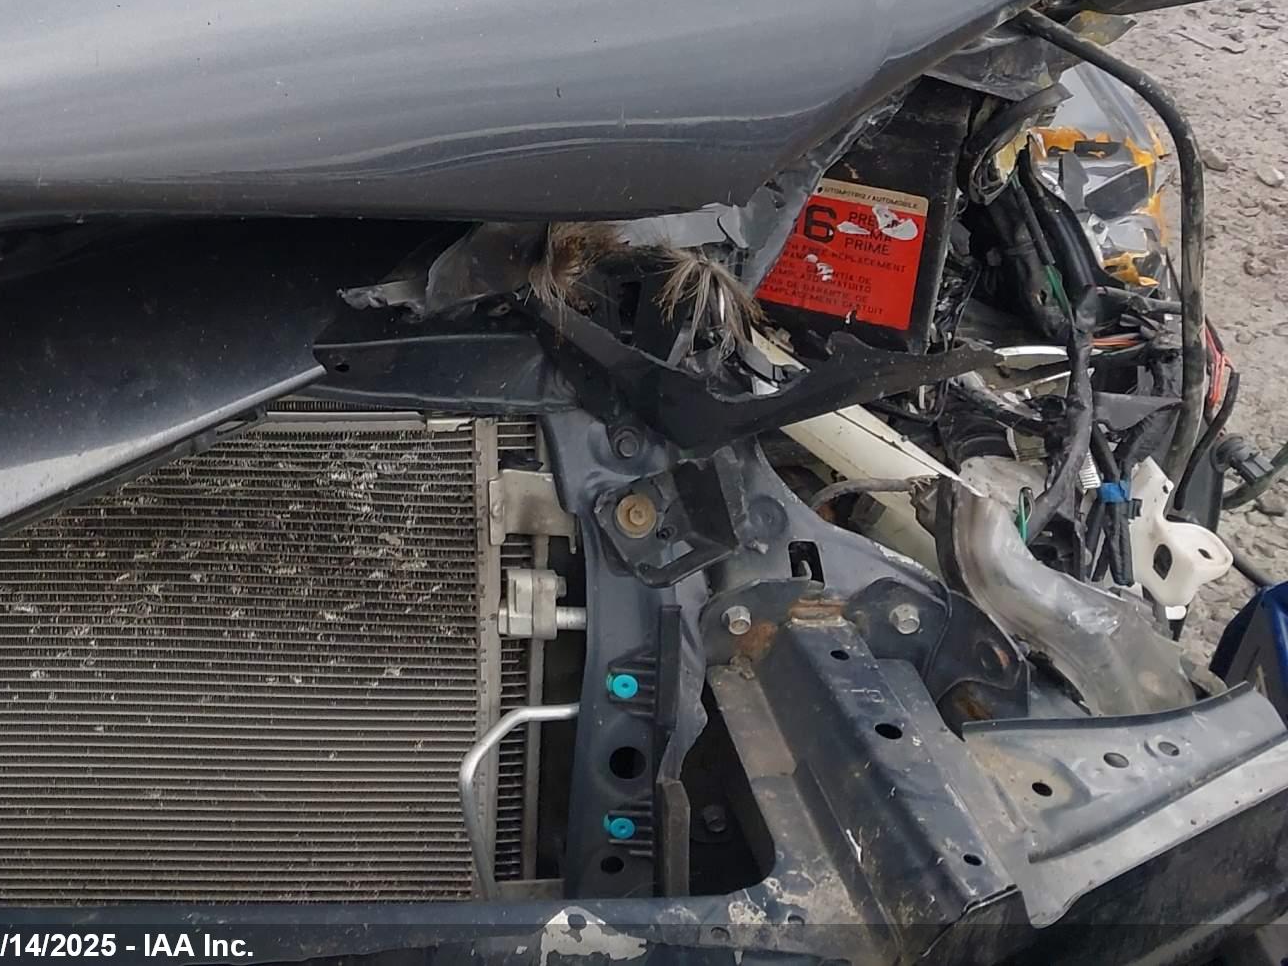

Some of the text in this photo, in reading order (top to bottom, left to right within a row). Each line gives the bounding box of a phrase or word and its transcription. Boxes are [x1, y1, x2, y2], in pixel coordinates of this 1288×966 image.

[871, 195, 918, 209] AUTOMOBILE
[844, 237, 890, 255] PRIME
[830, 252, 907, 273] REPLACEMENT
